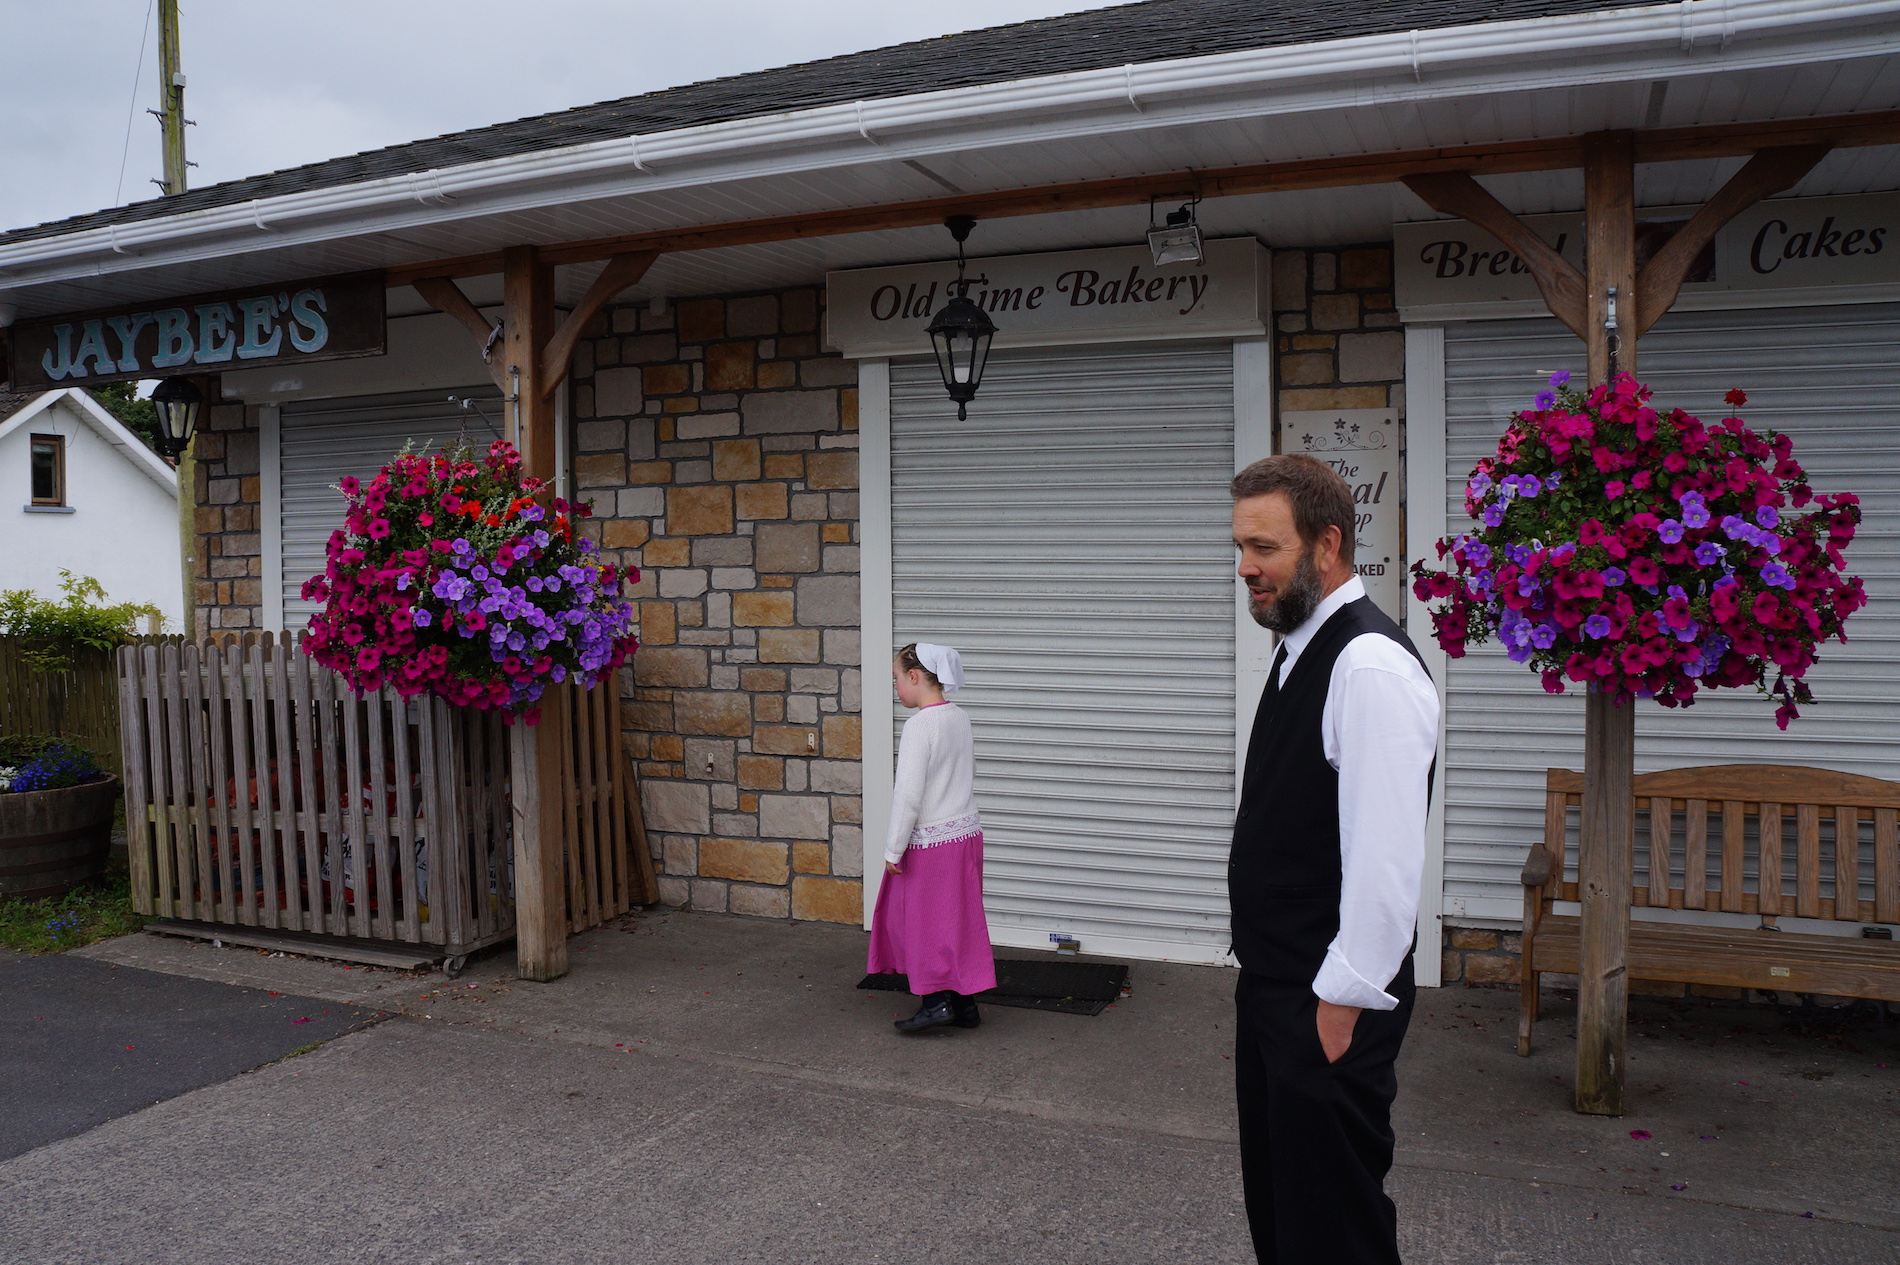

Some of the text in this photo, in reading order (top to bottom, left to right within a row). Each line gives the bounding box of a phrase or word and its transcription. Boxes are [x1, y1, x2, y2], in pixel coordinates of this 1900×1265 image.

[1751, 216, 1887, 274] Cakes
[870, 282, 937, 320] Old
[1056, 265, 1208, 315] Bakery
[42, 288, 328, 381] JAYBEE'S
[1353, 564, 1385, 576] AKED
